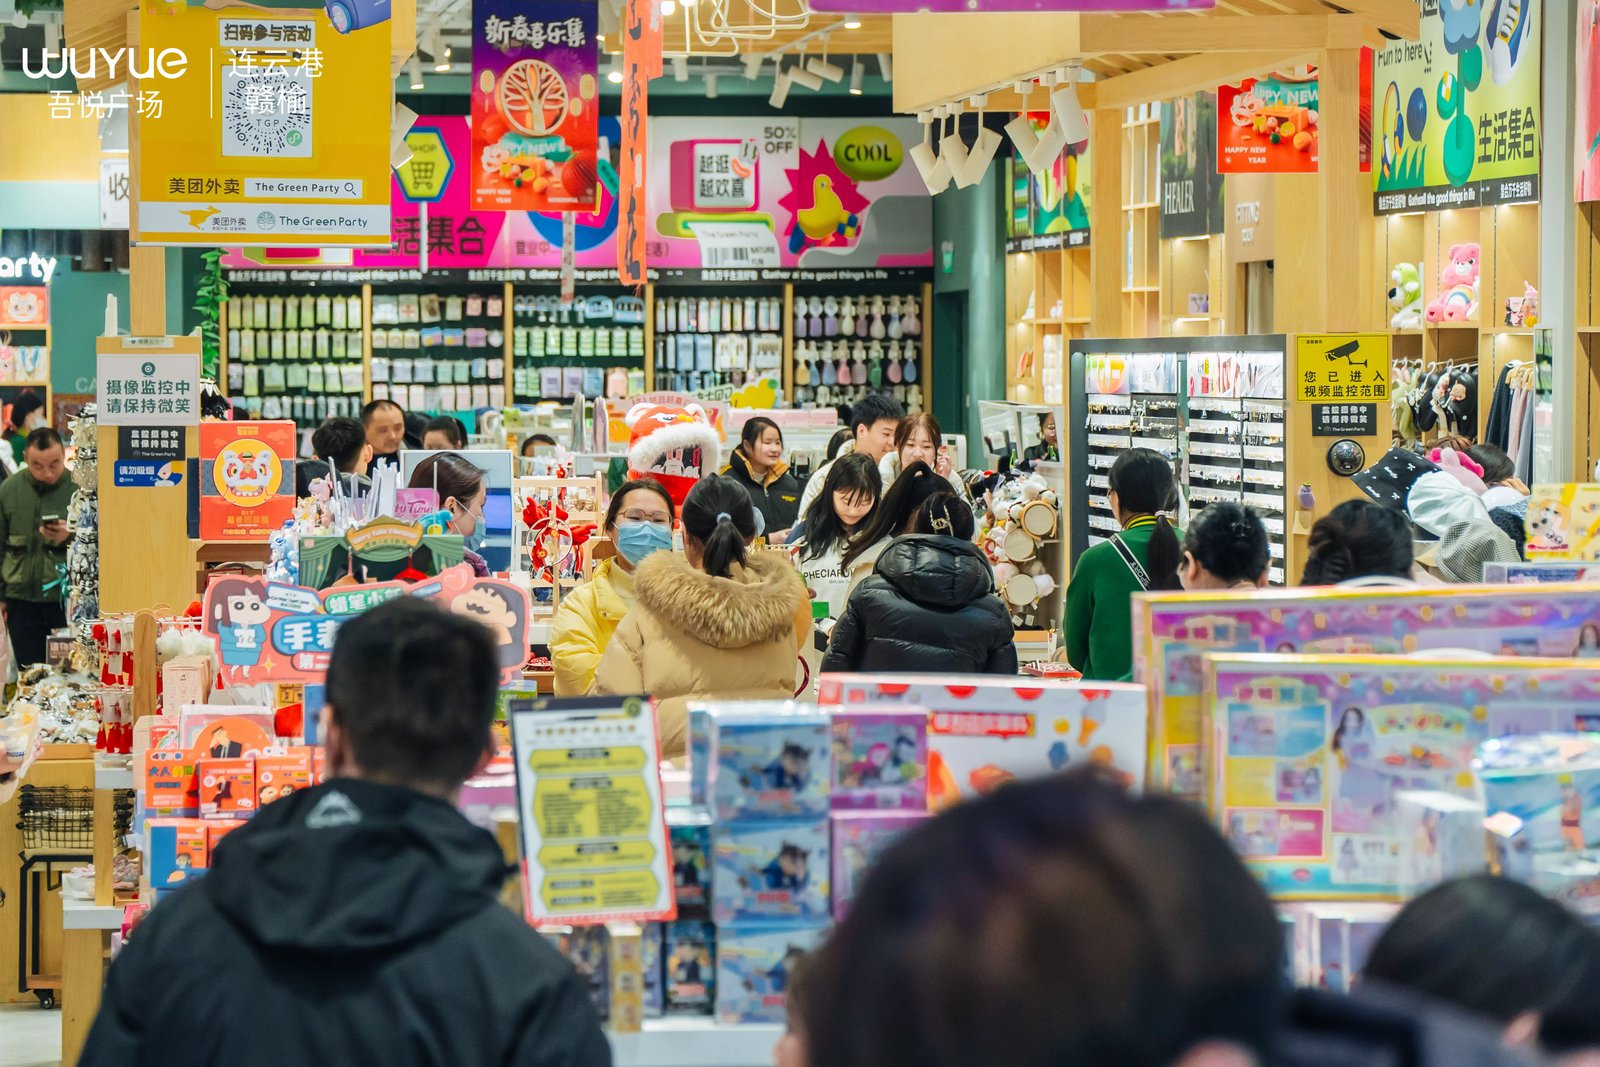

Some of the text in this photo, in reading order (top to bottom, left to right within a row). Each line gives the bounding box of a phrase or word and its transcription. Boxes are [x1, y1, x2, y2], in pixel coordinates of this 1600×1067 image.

[224, 23, 312, 42] 扫码参与活动
[485, 14, 586, 49] 新春喜乐集
[1395, 44, 1402, 64] to
[1404, 41, 1423, 62] here
[256, 119, 280, 127] TGP
[764, 127, 797, 139] 50%
[1478, 106, 1535, 164] 生活集合
[764, 142, 793, 154] OFF
[844, 144, 893, 162] COOL
[700, 154, 729, 174] 越逛
[169, 178, 240, 195] 美团外卖
[255, 183, 340, 194] The Green Party
[700, 178, 745, 198] 越欢喜
[1164, 180, 1195, 215] HEALER
[1427, 192, 1435, 205] the
[1436, 190, 1449, 207] good
[1449, 189, 1463, 204] things
[212, 217, 247, 226] 美团外卖
[279, 216, 368, 228] The Green Party
[362, 216, 485, 255] 活集合
[0, 252, 57, 282] arty
[290, 270, 320, 281] Gather
[348, 270, 371, 282] good
[371, 269, 398, 282] things
[399, 270, 408, 280] in
[529, 270, 559, 280] Gather
[585, 270, 608, 281] good
[762, 270, 791, 280] Gather
[801, 271, 814, 280] the
[816, 271, 837, 282] good
[838, 270, 865, 281] things
[866, 270, 874, 280] in
[875, 271, 888, 280] life
[1304, 371, 1384, 383] 您已进入
[107, 380, 190, 395] 摄像监控中
[1304, 385, 1385, 397] 视频监控范围
[107, 399, 190, 413] 请保持微笑
[1322, 406, 1367, 415] 监控摄像中
[1322, 415, 1367, 424] 请保持微笑
[131, 430, 178, 439] 监控摄像中
[131, 439, 178, 448] 请保持微笑
[119, 466, 154, 475] 请勿吸烟
[407, 500, 433, 514] Time
[1130, 562, 1149, 587] SPORT
